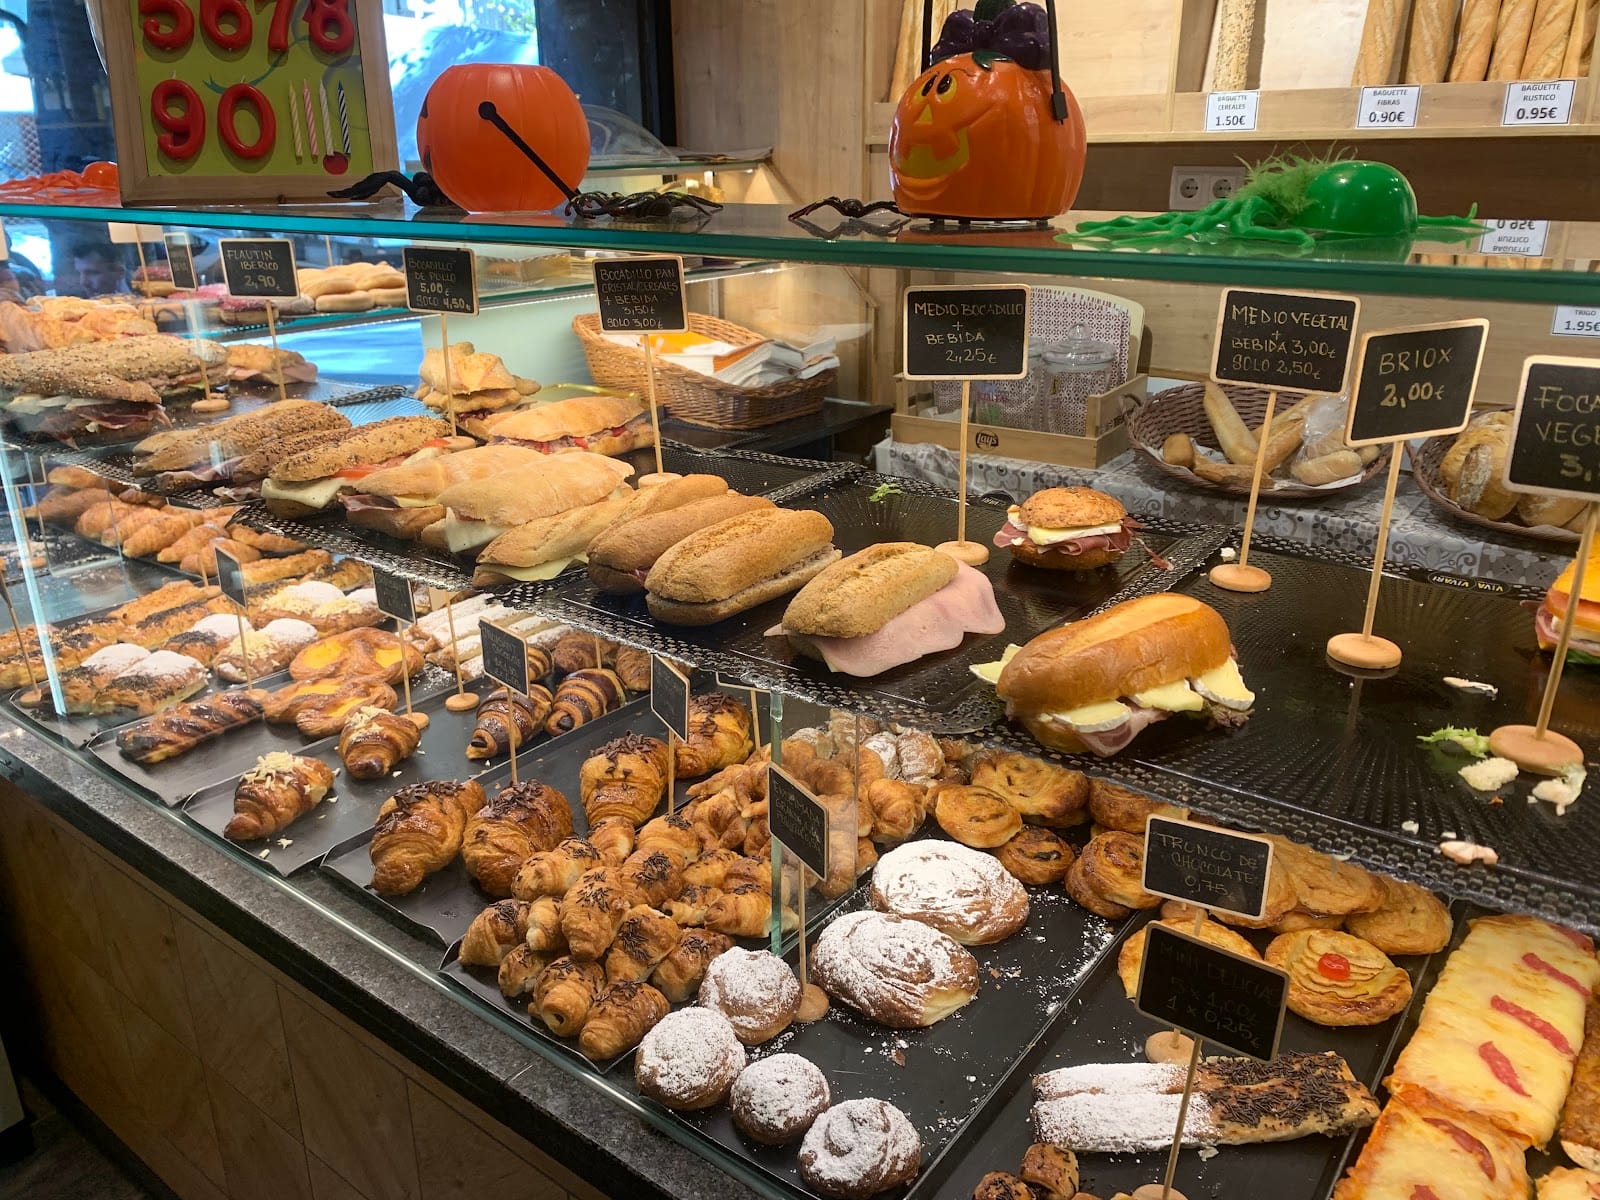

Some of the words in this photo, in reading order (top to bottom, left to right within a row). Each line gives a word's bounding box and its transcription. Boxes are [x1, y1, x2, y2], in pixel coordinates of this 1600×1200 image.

[1368, 112, 1406, 122] 0.90€
[1516, 107, 1558, 120] 0.95€
[1216, 115, 1246, 126] 1.50€
[226, 250, 273, 260] FLAUTIN
[240, 261, 279, 270] IBERICO
[656, 268, 675, 279] PAN
[614, 294, 658, 304] BEBIDA
[914, 302, 959, 316] MEDIO
[961, 303, 1024, 316] BOCADILLO
[606, 318, 630, 328] SOLO
[1232, 304, 1288, 326] MEDIO
[1290, 311, 1349, 331] VEGETAL
[952, 321, 964, 331] +
[1564, 320, 1600, 332] 1.95€
[925, 332, 986, 345] BEBIDA
[1272, 330, 1281, 340] +
[1232, 337, 1288, 354] BEBIDA
[1232, 354, 1270, 372] SOLO
[1378, 347, 1453, 376] BRIOX
[1379, 382, 1445, 409] 2,00€
[1432, 576, 1469, 588] VIVARI
[1478, 582, 1504, 592] VIVA
[1171, 851, 1254, 884] CHOCOLATE
[1240, 855, 1258, 869] DE
